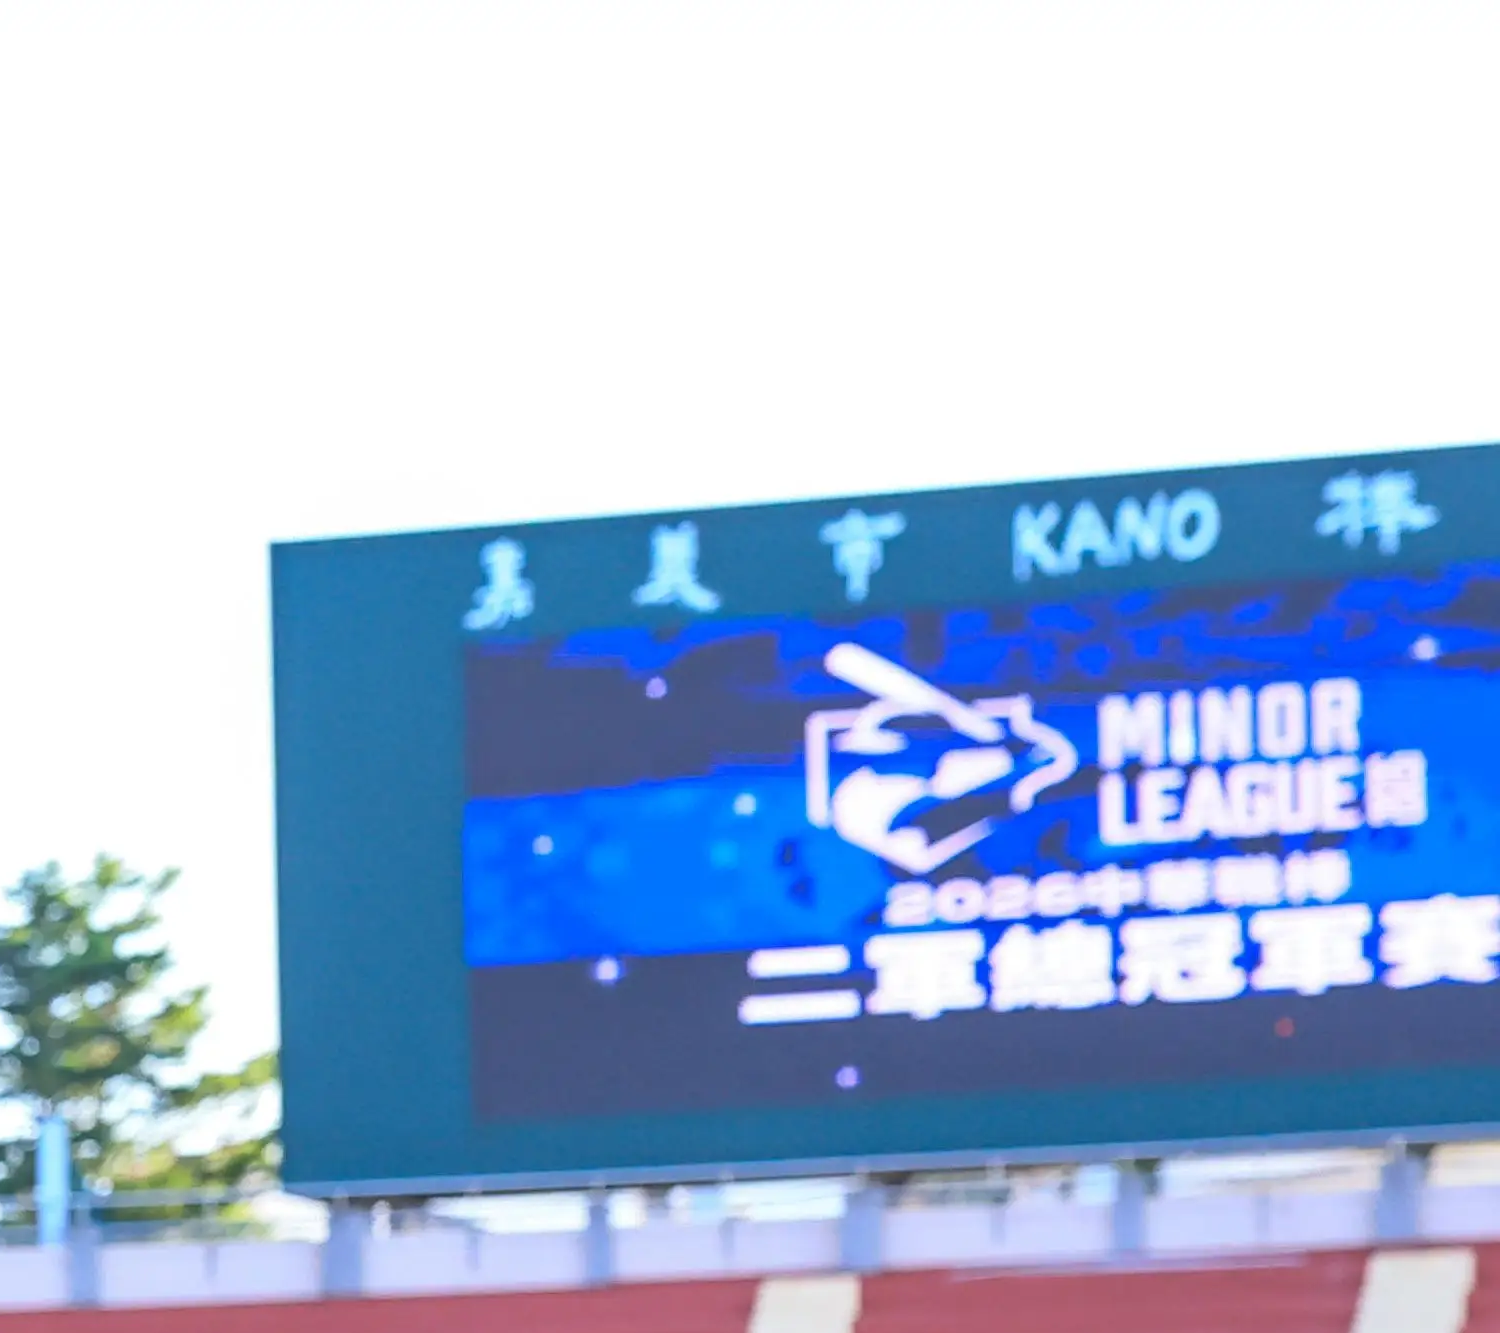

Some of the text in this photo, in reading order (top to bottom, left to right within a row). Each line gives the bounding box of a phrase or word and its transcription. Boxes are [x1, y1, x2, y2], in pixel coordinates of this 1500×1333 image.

[1012, 487, 1221, 583] KANO
[1097, 676, 1363, 770] MINOR
[1097, 754, 1366, 847] LEAGUE
